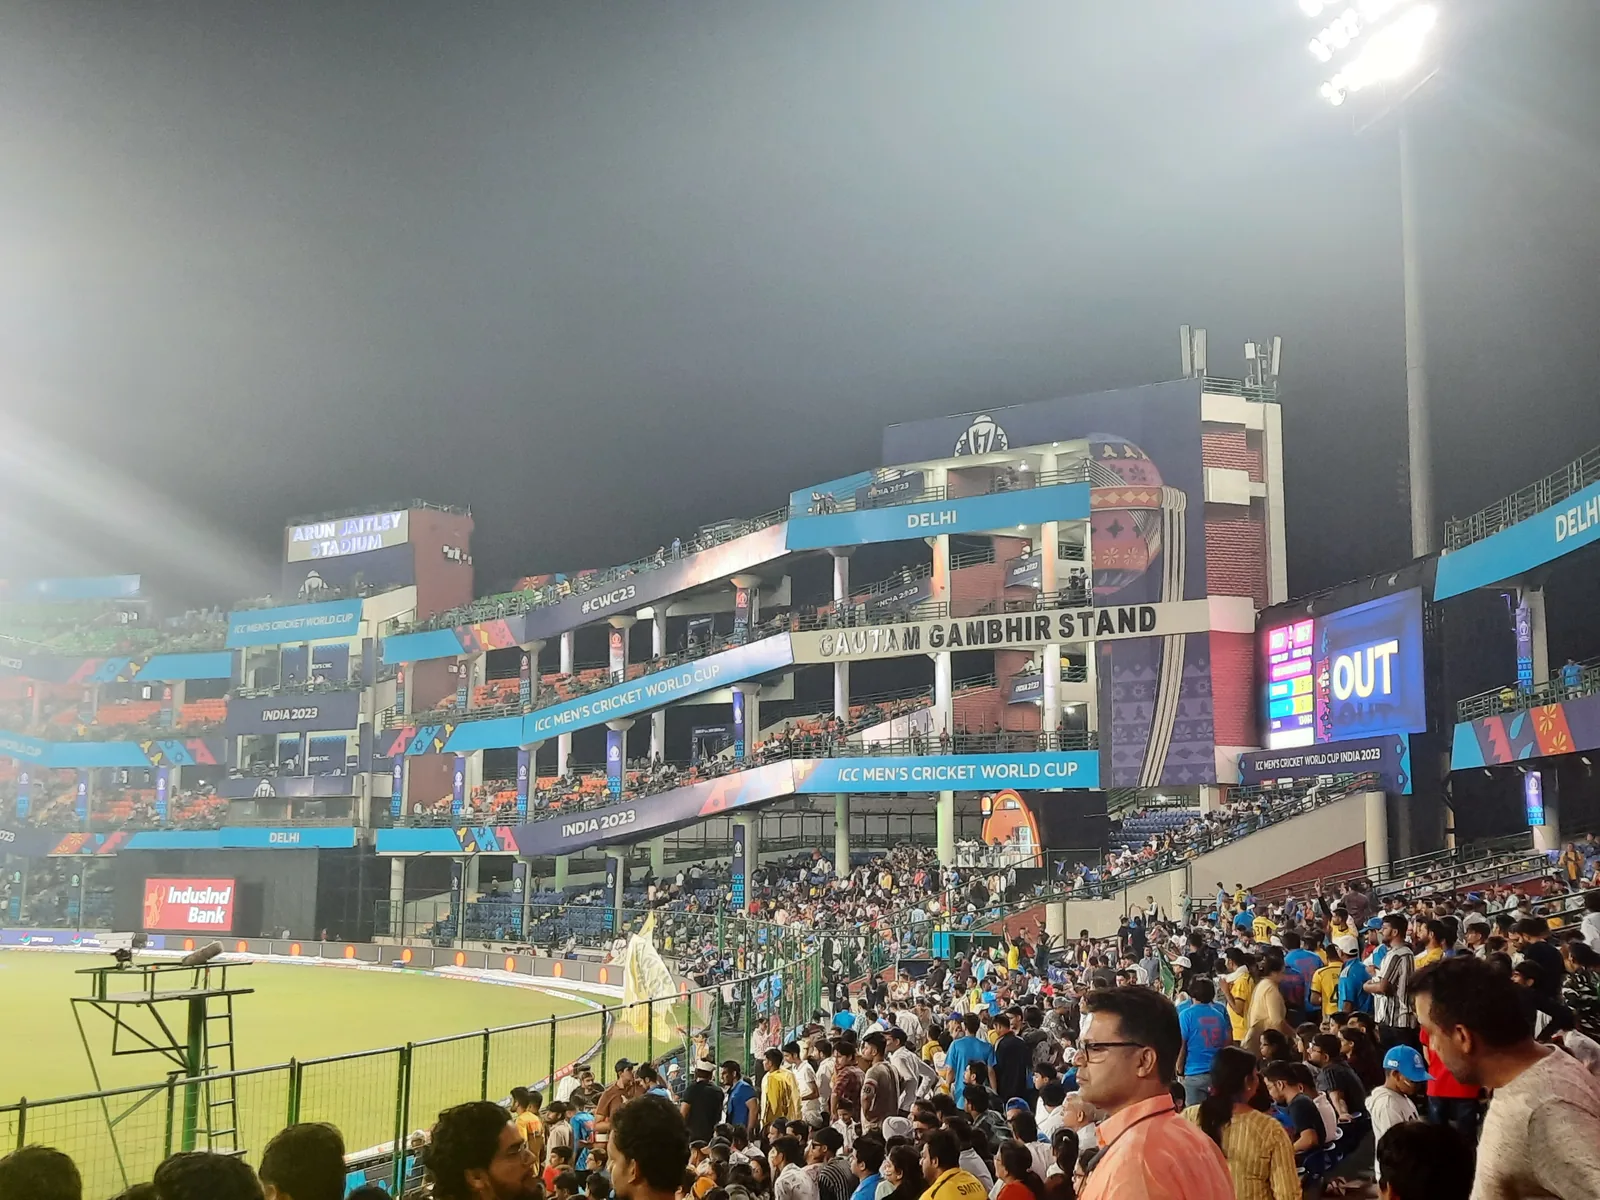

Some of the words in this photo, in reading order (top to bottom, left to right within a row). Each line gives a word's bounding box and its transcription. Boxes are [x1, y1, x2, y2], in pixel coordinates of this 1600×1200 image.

[293, 523, 336, 541] ARUN
[339, 511, 401, 536] JAITLEY
[907, 510, 957, 528] DELHI
[581, 585, 636, 614] #CWC23
[271, 618, 305, 631] CRICKET
[306, 615, 336, 626] WORLD
[336, 613, 354, 623] CUP
[819, 626, 920, 656] GAUTAM
[929, 615, 1052, 647] GAMBHIR
[1058, 606, 1157, 638] STAND
[1333, 639, 1399, 701] OUT
[535, 716, 552, 732] ICC
[553, 705, 590, 727] MEN'S
[592, 688, 642, 714] CRICKET
[645, 673, 691, 698] WORLD
[694, 664, 720, 682] CUP
[262, 709, 290, 721] INDIA
[291, 707, 318, 719] 2023
[1264, 759, 1280, 769] MEN'S
[1280, 756, 1304, 768] CRICKET
[1305, 753, 1326, 765] WORLD
[1327, 753, 1340, 763] CUP
[1340, 751, 1360, 762] INDIA
[1361, 748, 1381, 760] 2023
[838, 768, 860, 781] ICC
[863, 767, 909, 781] MEN'S
[911, 765, 976, 780] CRICKET
[981, 763, 1040, 778] WORLD
[1044, 762, 1078, 777] CUP
[562, 819, 599, 837] INDIA
[600, 810, 636, 829] 2023
[269, 832, 300, 843] DELHI
[167, 886, 232, 904] IndusInd
[188, 906, 226, 924] Bank
[1255, 925, 1264, 936] 31
